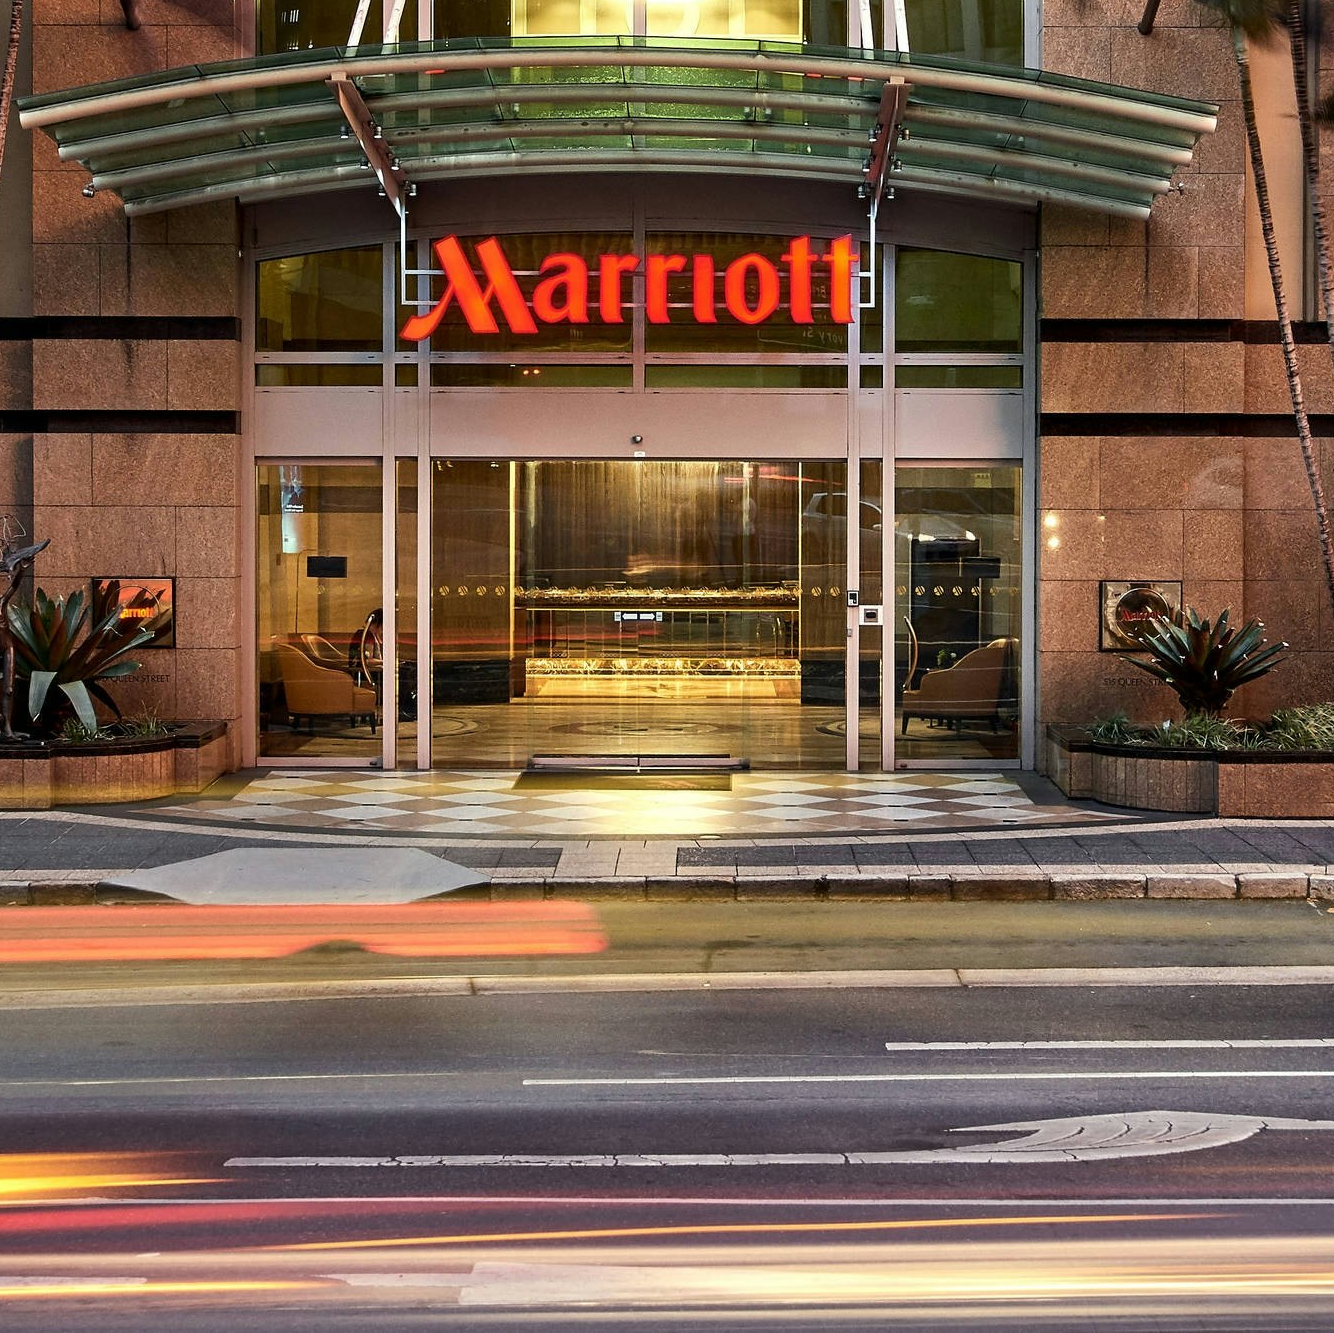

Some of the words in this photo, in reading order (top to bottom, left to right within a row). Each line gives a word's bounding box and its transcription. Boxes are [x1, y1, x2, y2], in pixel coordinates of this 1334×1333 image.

[399, 233, 860, 341] Marriott
[118, 607, 156, 618] arriott
[142, 674, 170, 683] STREET
[1117, 677, 1147, 686] QUEEN
